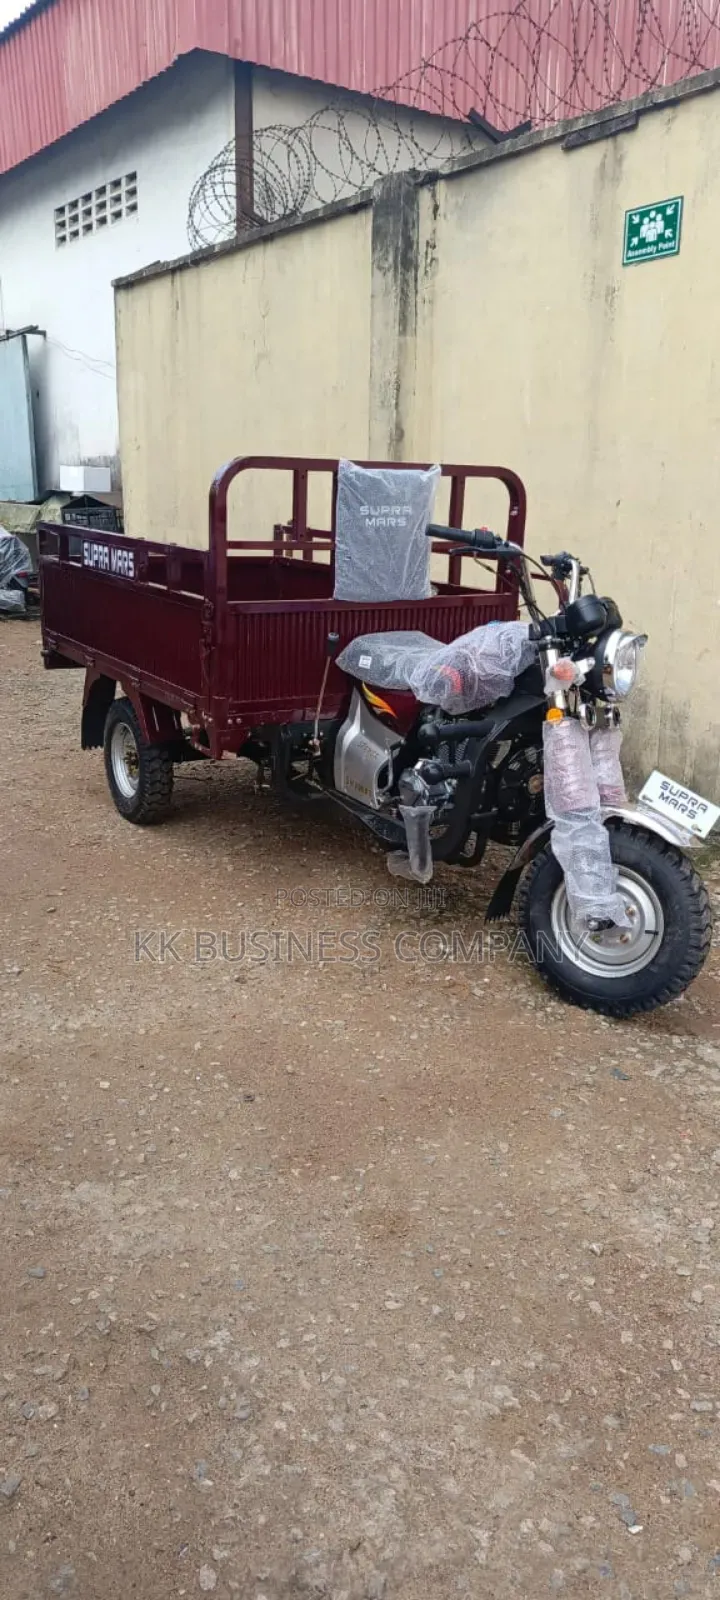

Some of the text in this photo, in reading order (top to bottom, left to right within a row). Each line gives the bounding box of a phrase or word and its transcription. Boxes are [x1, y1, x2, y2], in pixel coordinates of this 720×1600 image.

[627, 240, 675, 257] Assembly Point
[360, 505, 412, 516] SUPRA
[365, 516, 407, 527] MARS
[83, 542, 110, 570] SUPRA
[658, 791, 698, 820] MARS
[659, 780, 709, 814] SUPRA
